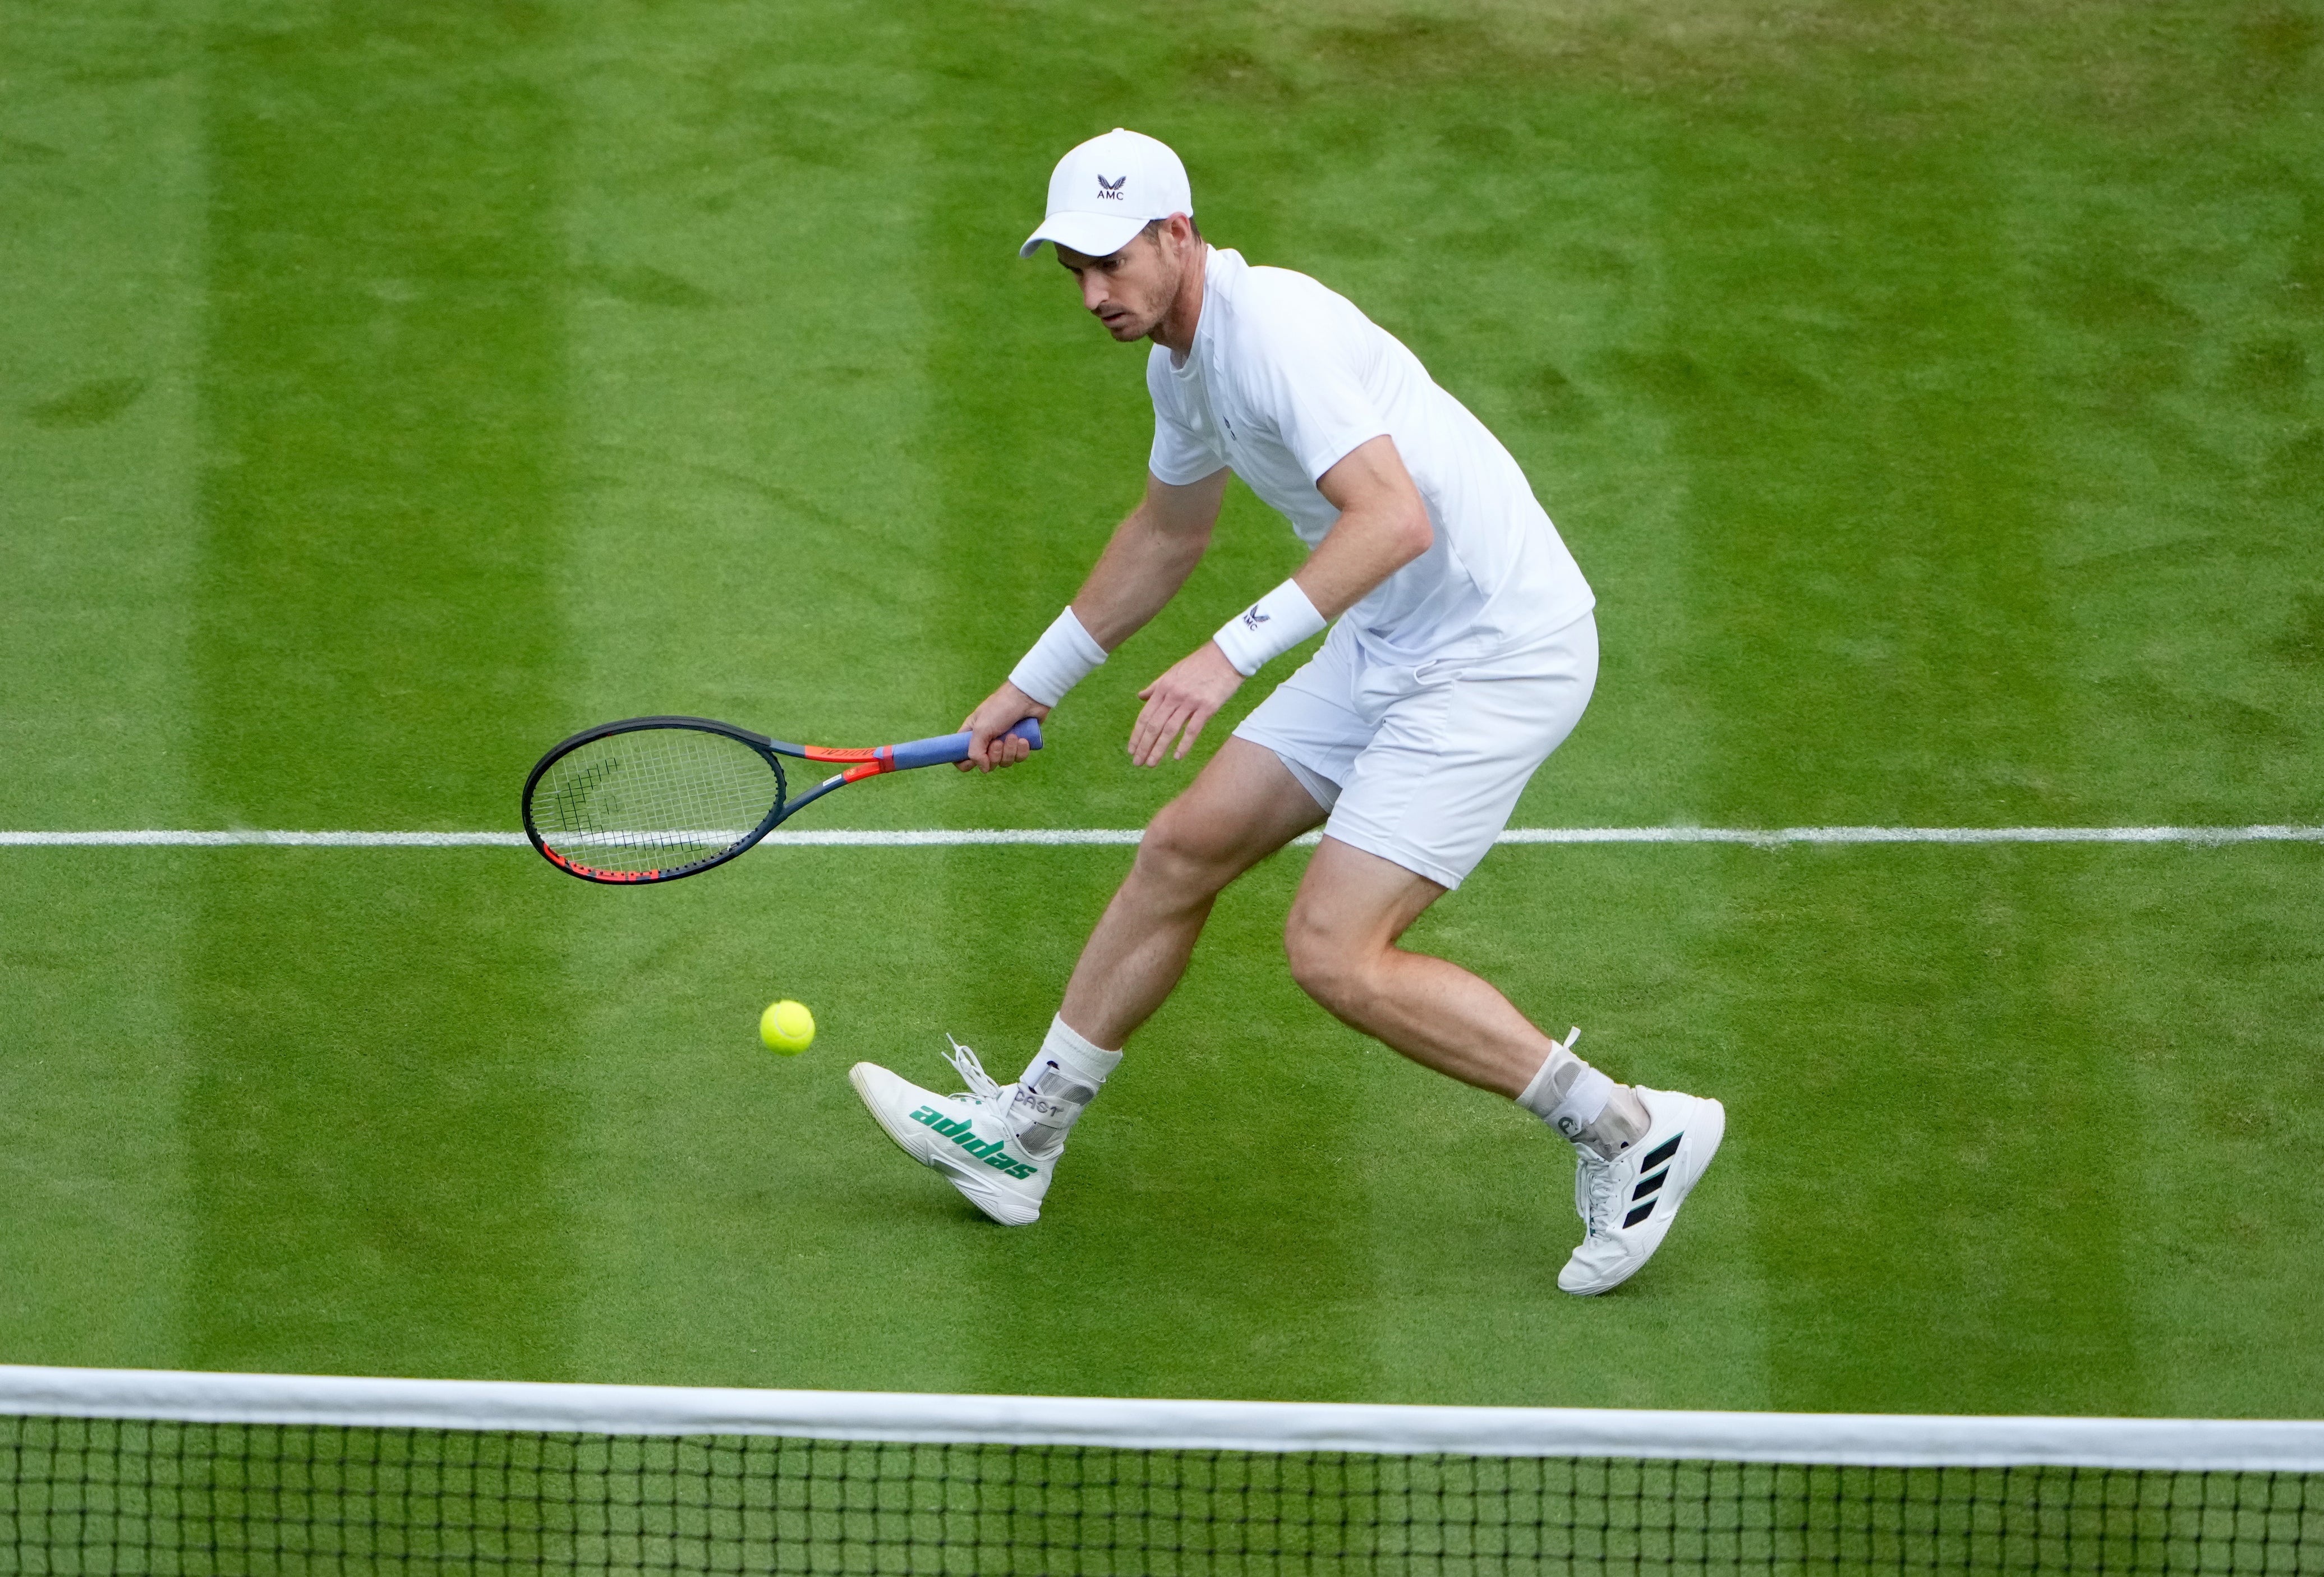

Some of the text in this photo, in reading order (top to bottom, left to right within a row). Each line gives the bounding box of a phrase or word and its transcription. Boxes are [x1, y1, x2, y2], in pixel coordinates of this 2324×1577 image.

[1097, 190, 1124, 200] AMC
[1242, 614, 1258, 631] AMC
[909, 1105, 1037, 1180] adidas
